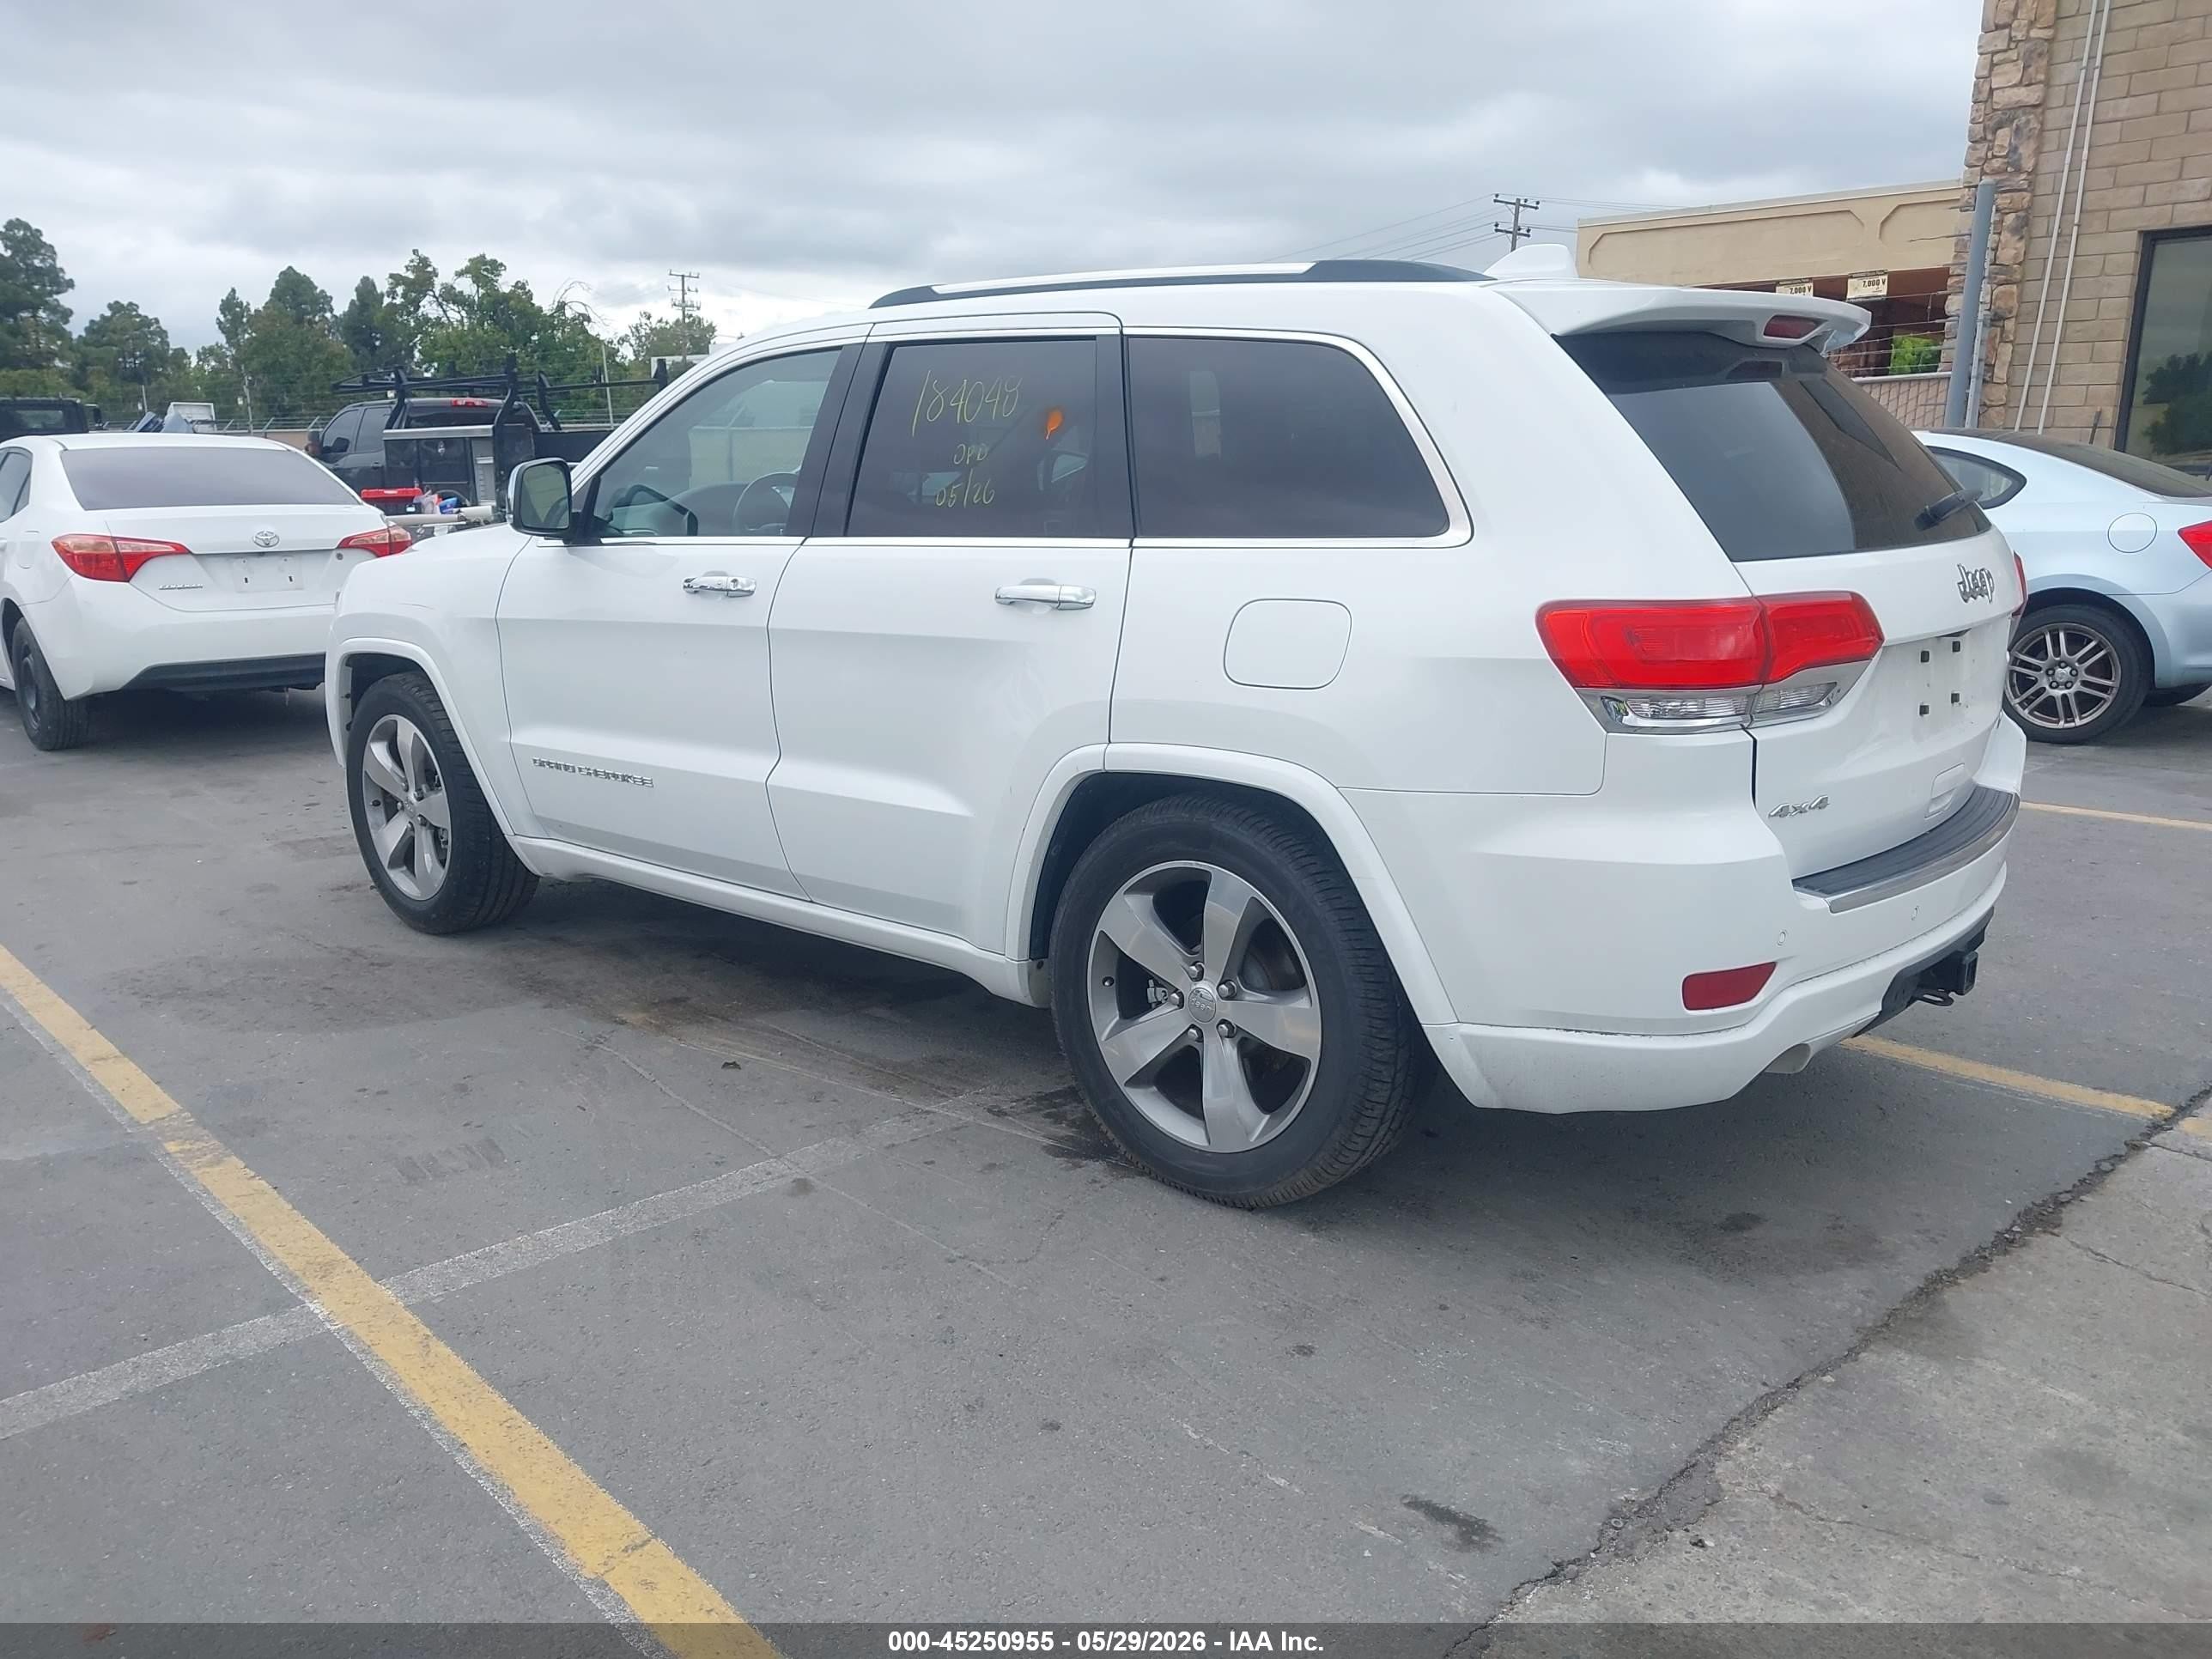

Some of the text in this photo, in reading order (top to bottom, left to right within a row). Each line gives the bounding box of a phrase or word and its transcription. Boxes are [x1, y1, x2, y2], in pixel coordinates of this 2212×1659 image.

[1881, 277, 1887, 286] V
[1956, 562, 1995, 605] Jeep
[576, 765, 654, 789] CHEROKEE
